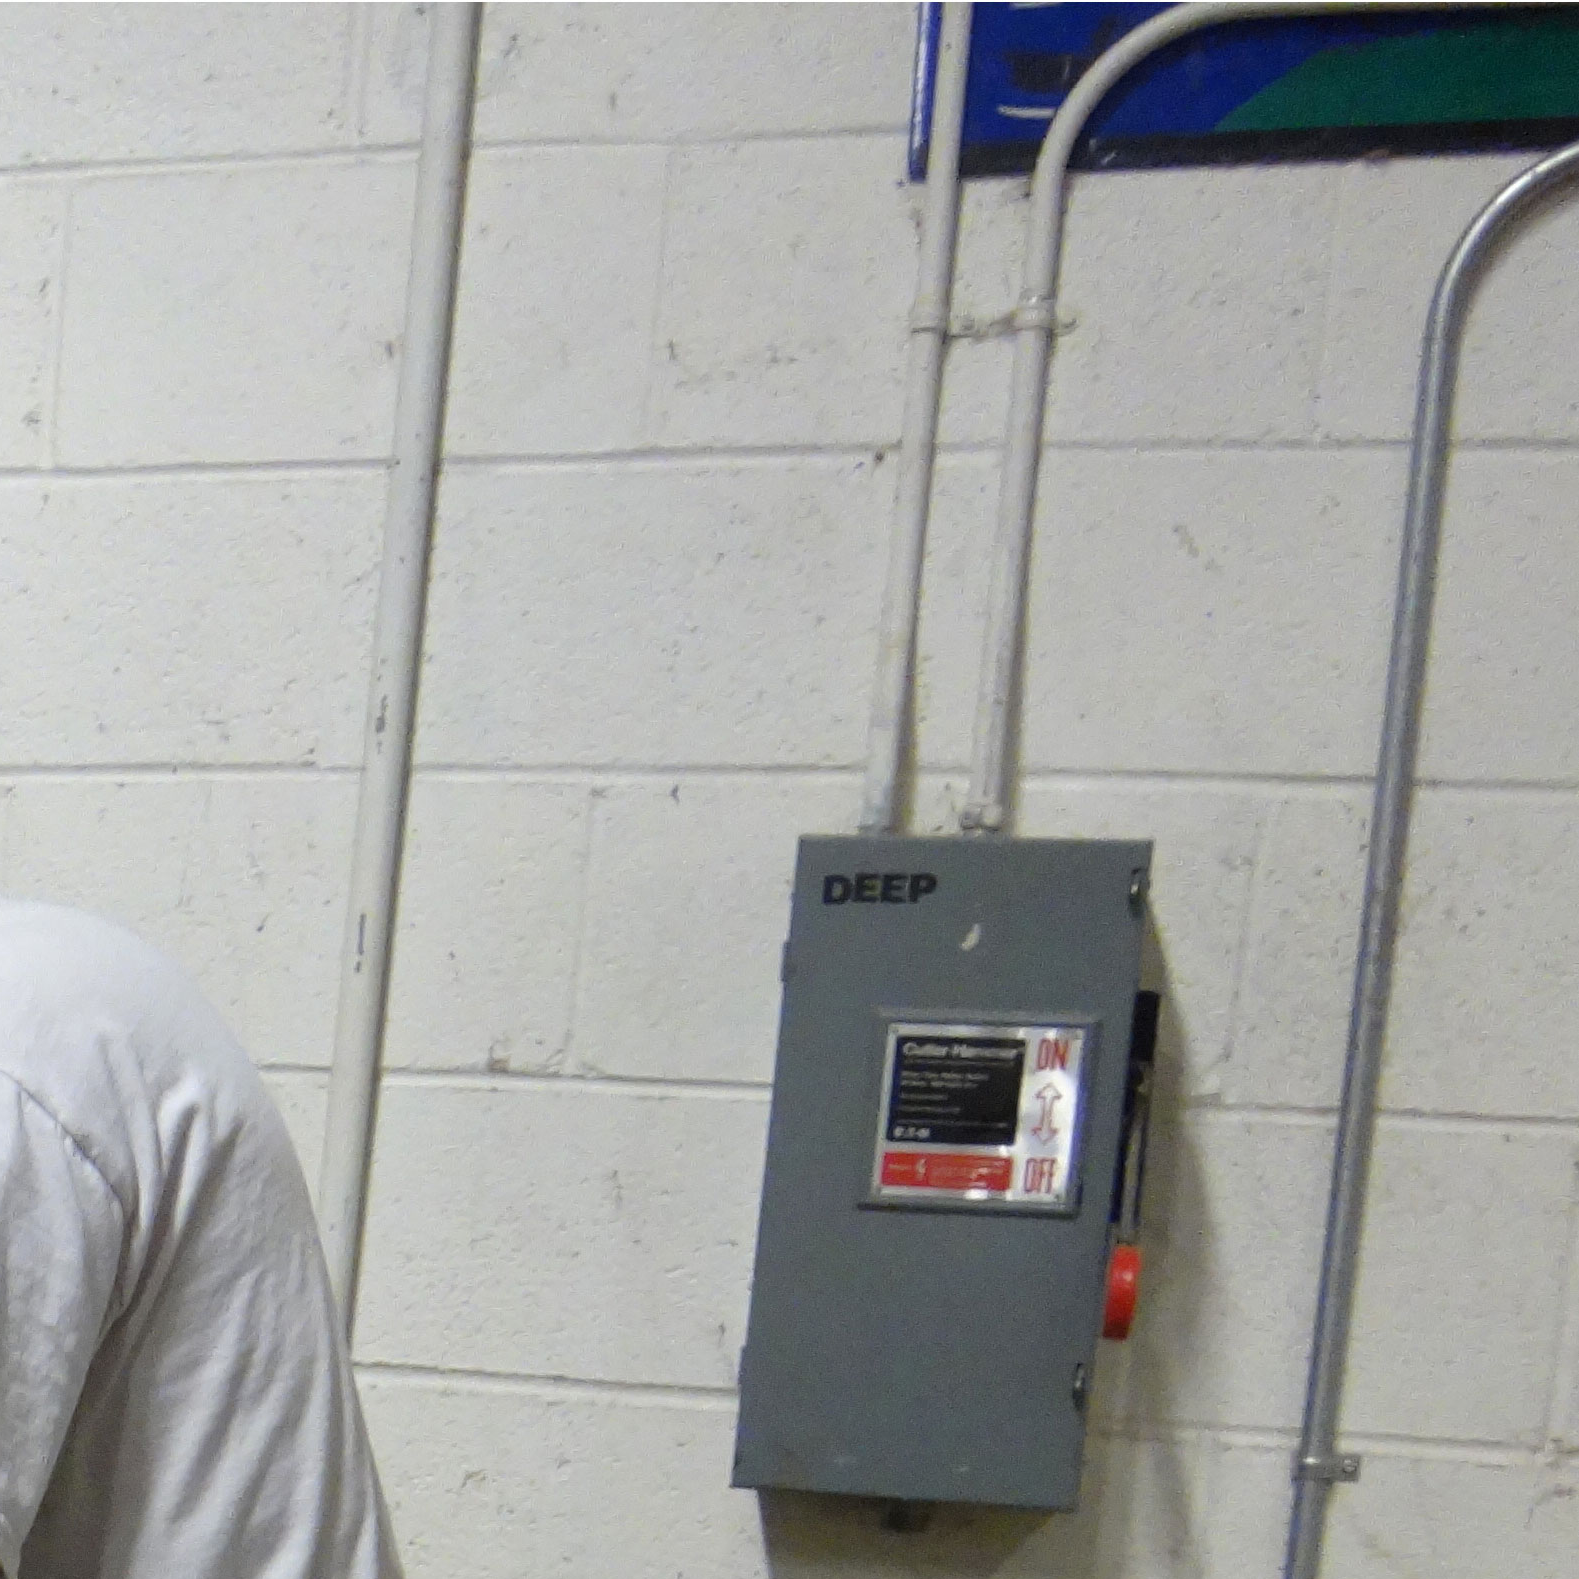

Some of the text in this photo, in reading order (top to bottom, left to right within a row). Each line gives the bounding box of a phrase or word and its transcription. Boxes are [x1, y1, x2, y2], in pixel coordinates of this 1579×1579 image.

[821, 872, 937, 905] DEEP
[1035, 1038, 1071, 1070] ON
[1023, 1157, 1058, 1194] OFF
